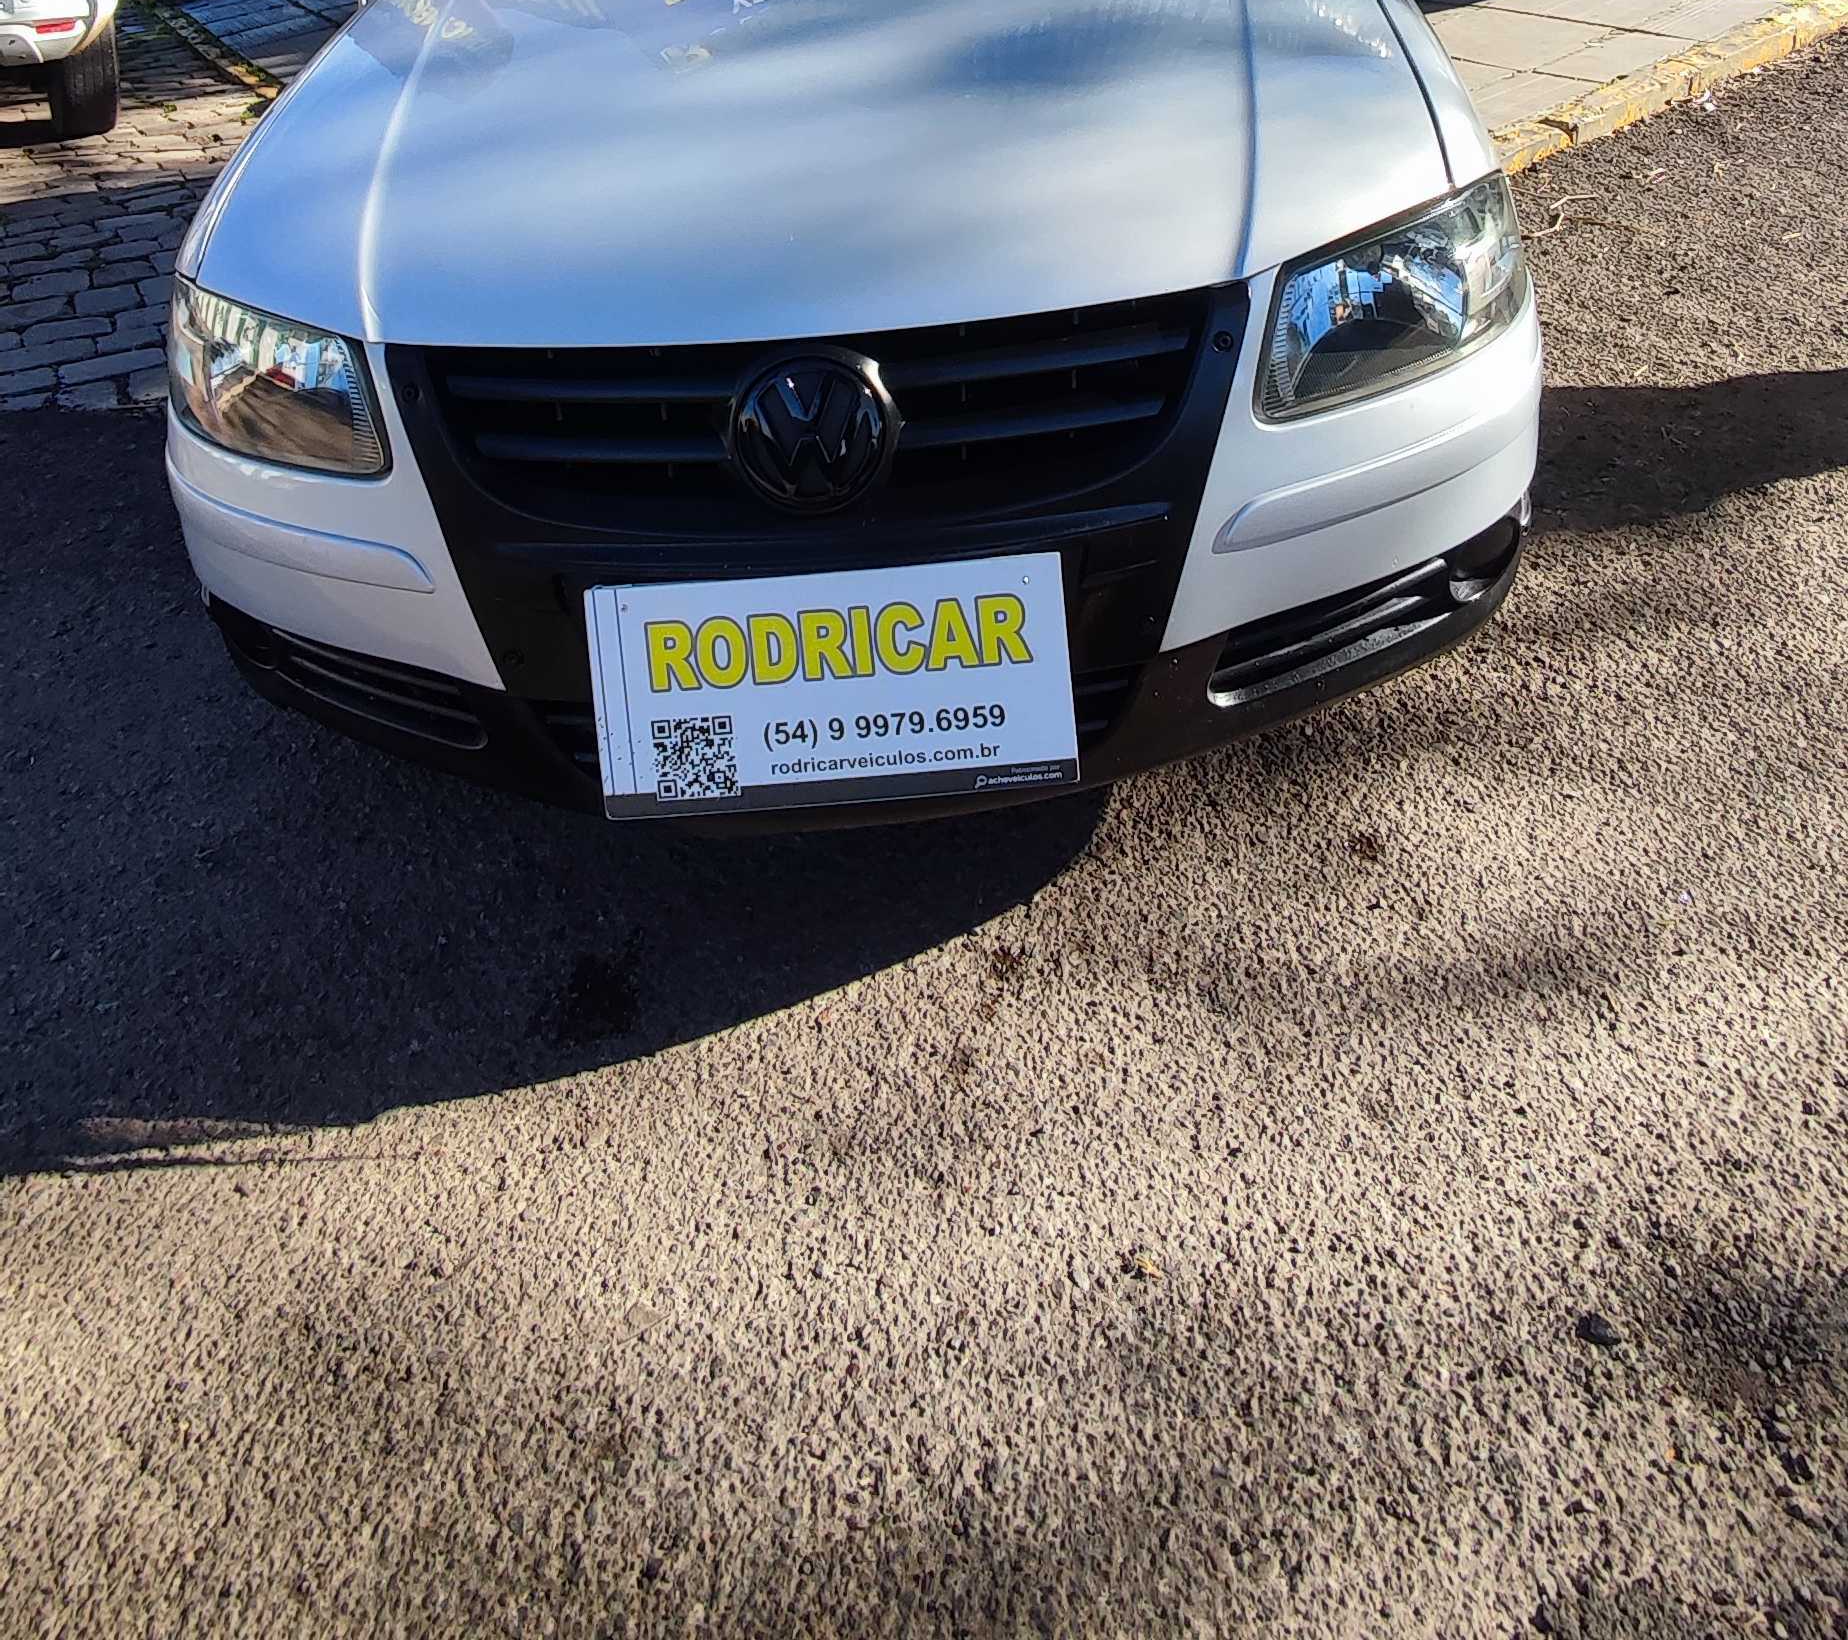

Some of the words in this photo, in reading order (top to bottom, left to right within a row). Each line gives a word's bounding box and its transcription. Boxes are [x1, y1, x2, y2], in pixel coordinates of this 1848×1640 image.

[644, 593, 1033, 693] RODRICAR
[763, 719, 818, 752] (54)
[828, 717, 845, 741] 9
[855, 704, 1006, 739] 9979.6959
[771, 742, 1001, 775] rodricarveiculos.com.br
